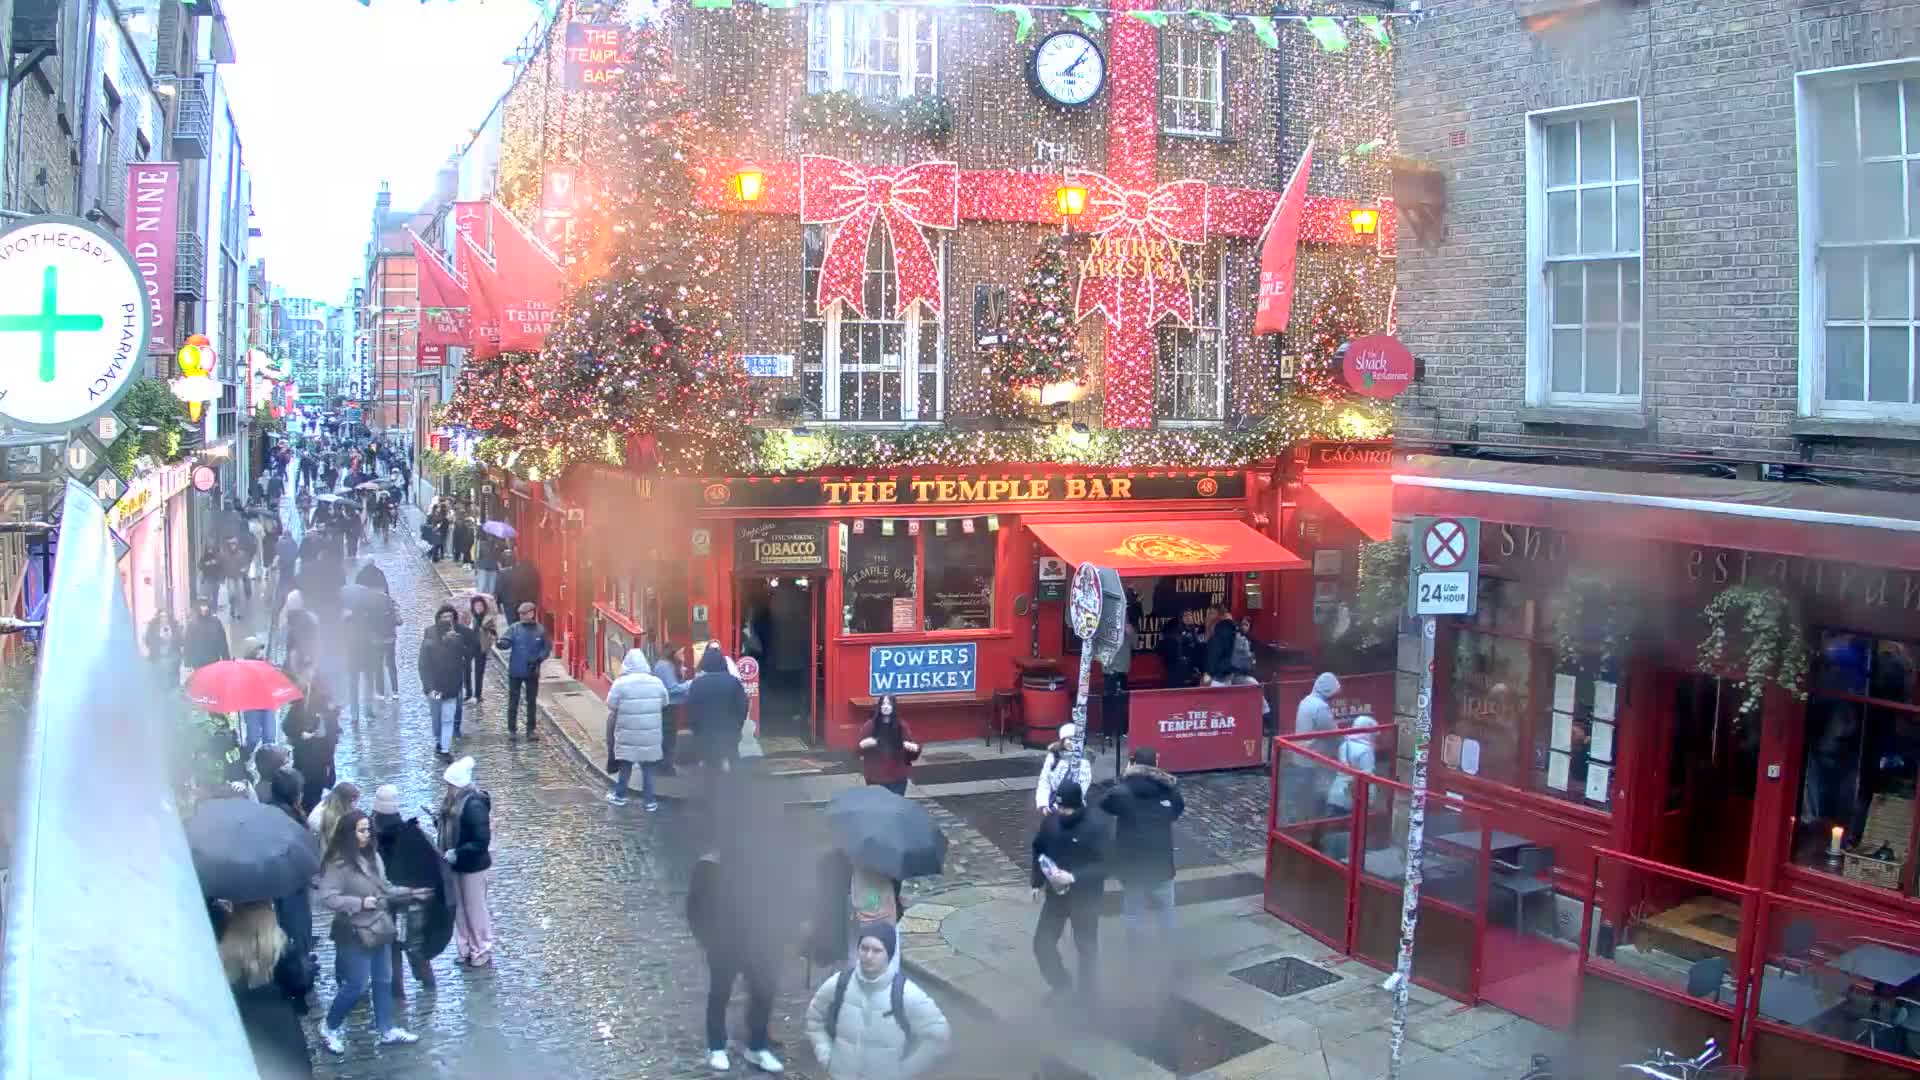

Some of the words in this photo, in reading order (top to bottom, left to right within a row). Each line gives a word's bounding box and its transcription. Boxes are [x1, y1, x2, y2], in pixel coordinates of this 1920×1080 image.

[583, 29, 617, 45] THE
[136, 171, 169, 232] NINE
[1088, 236, 1181, 262] MERRY
[87, 302, 135, 402] PHARMACY
[707, 486, 724, 499] 48
[824, 481, 898, 503] THE
[912, 479, 1049, 502] TEMPLE
[1064, 477, 1133, 500] BAR
[1200, 480, 1213, 493] 48
[750, 539, 816, 561] TOBACCO
[1175, 578, 1225, 593] EMPEROR
[1420, 584, 1442, 603] 24
[1443, 594, 1466, 602] HOUR
[879, 648, 969, 667] POWER'S
[873, 670, 973, 689] WHISKEY
[1158, 719, 1207, 733] TEMPLE
[1210, 716, 1236, 729] BAR
[1187, 711, 1209, 720] THE
